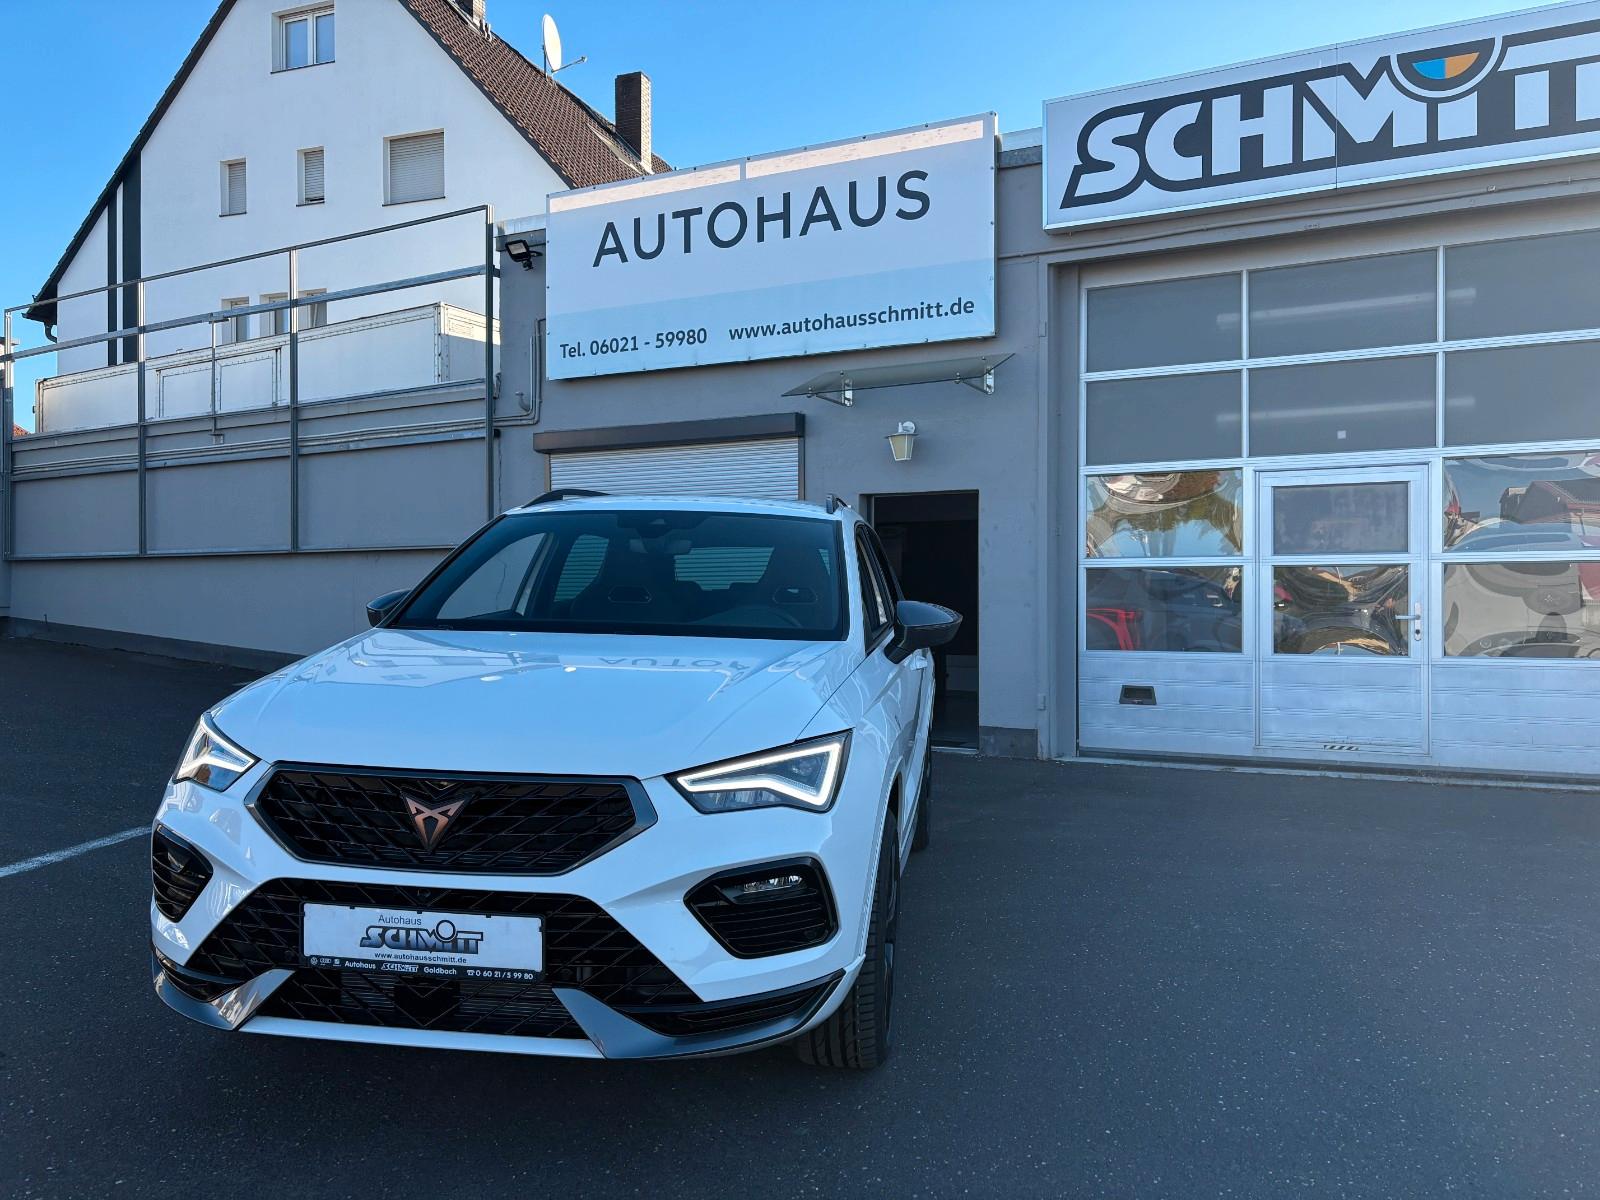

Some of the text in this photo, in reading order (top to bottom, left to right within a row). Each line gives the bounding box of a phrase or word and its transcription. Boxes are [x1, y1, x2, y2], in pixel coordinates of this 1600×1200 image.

[593, 170, 931, 267] AUTOHAUS
[560, 341, 586, 358] Tel.
[590, 336, 639, 355] 06021
[656, 328, 707, 349] 59980
[729, 297, 975, 340] www.autohausschmitt.de
[378, 914, 422, 926] Autohaus
[359, 919, 484, 955] SCHMITT
[344, 960, 376, 970] Autohaus
[423, 966, 457, 975] Goldbach
[374, 952, 467, 964] www.autohausschmitt.de
